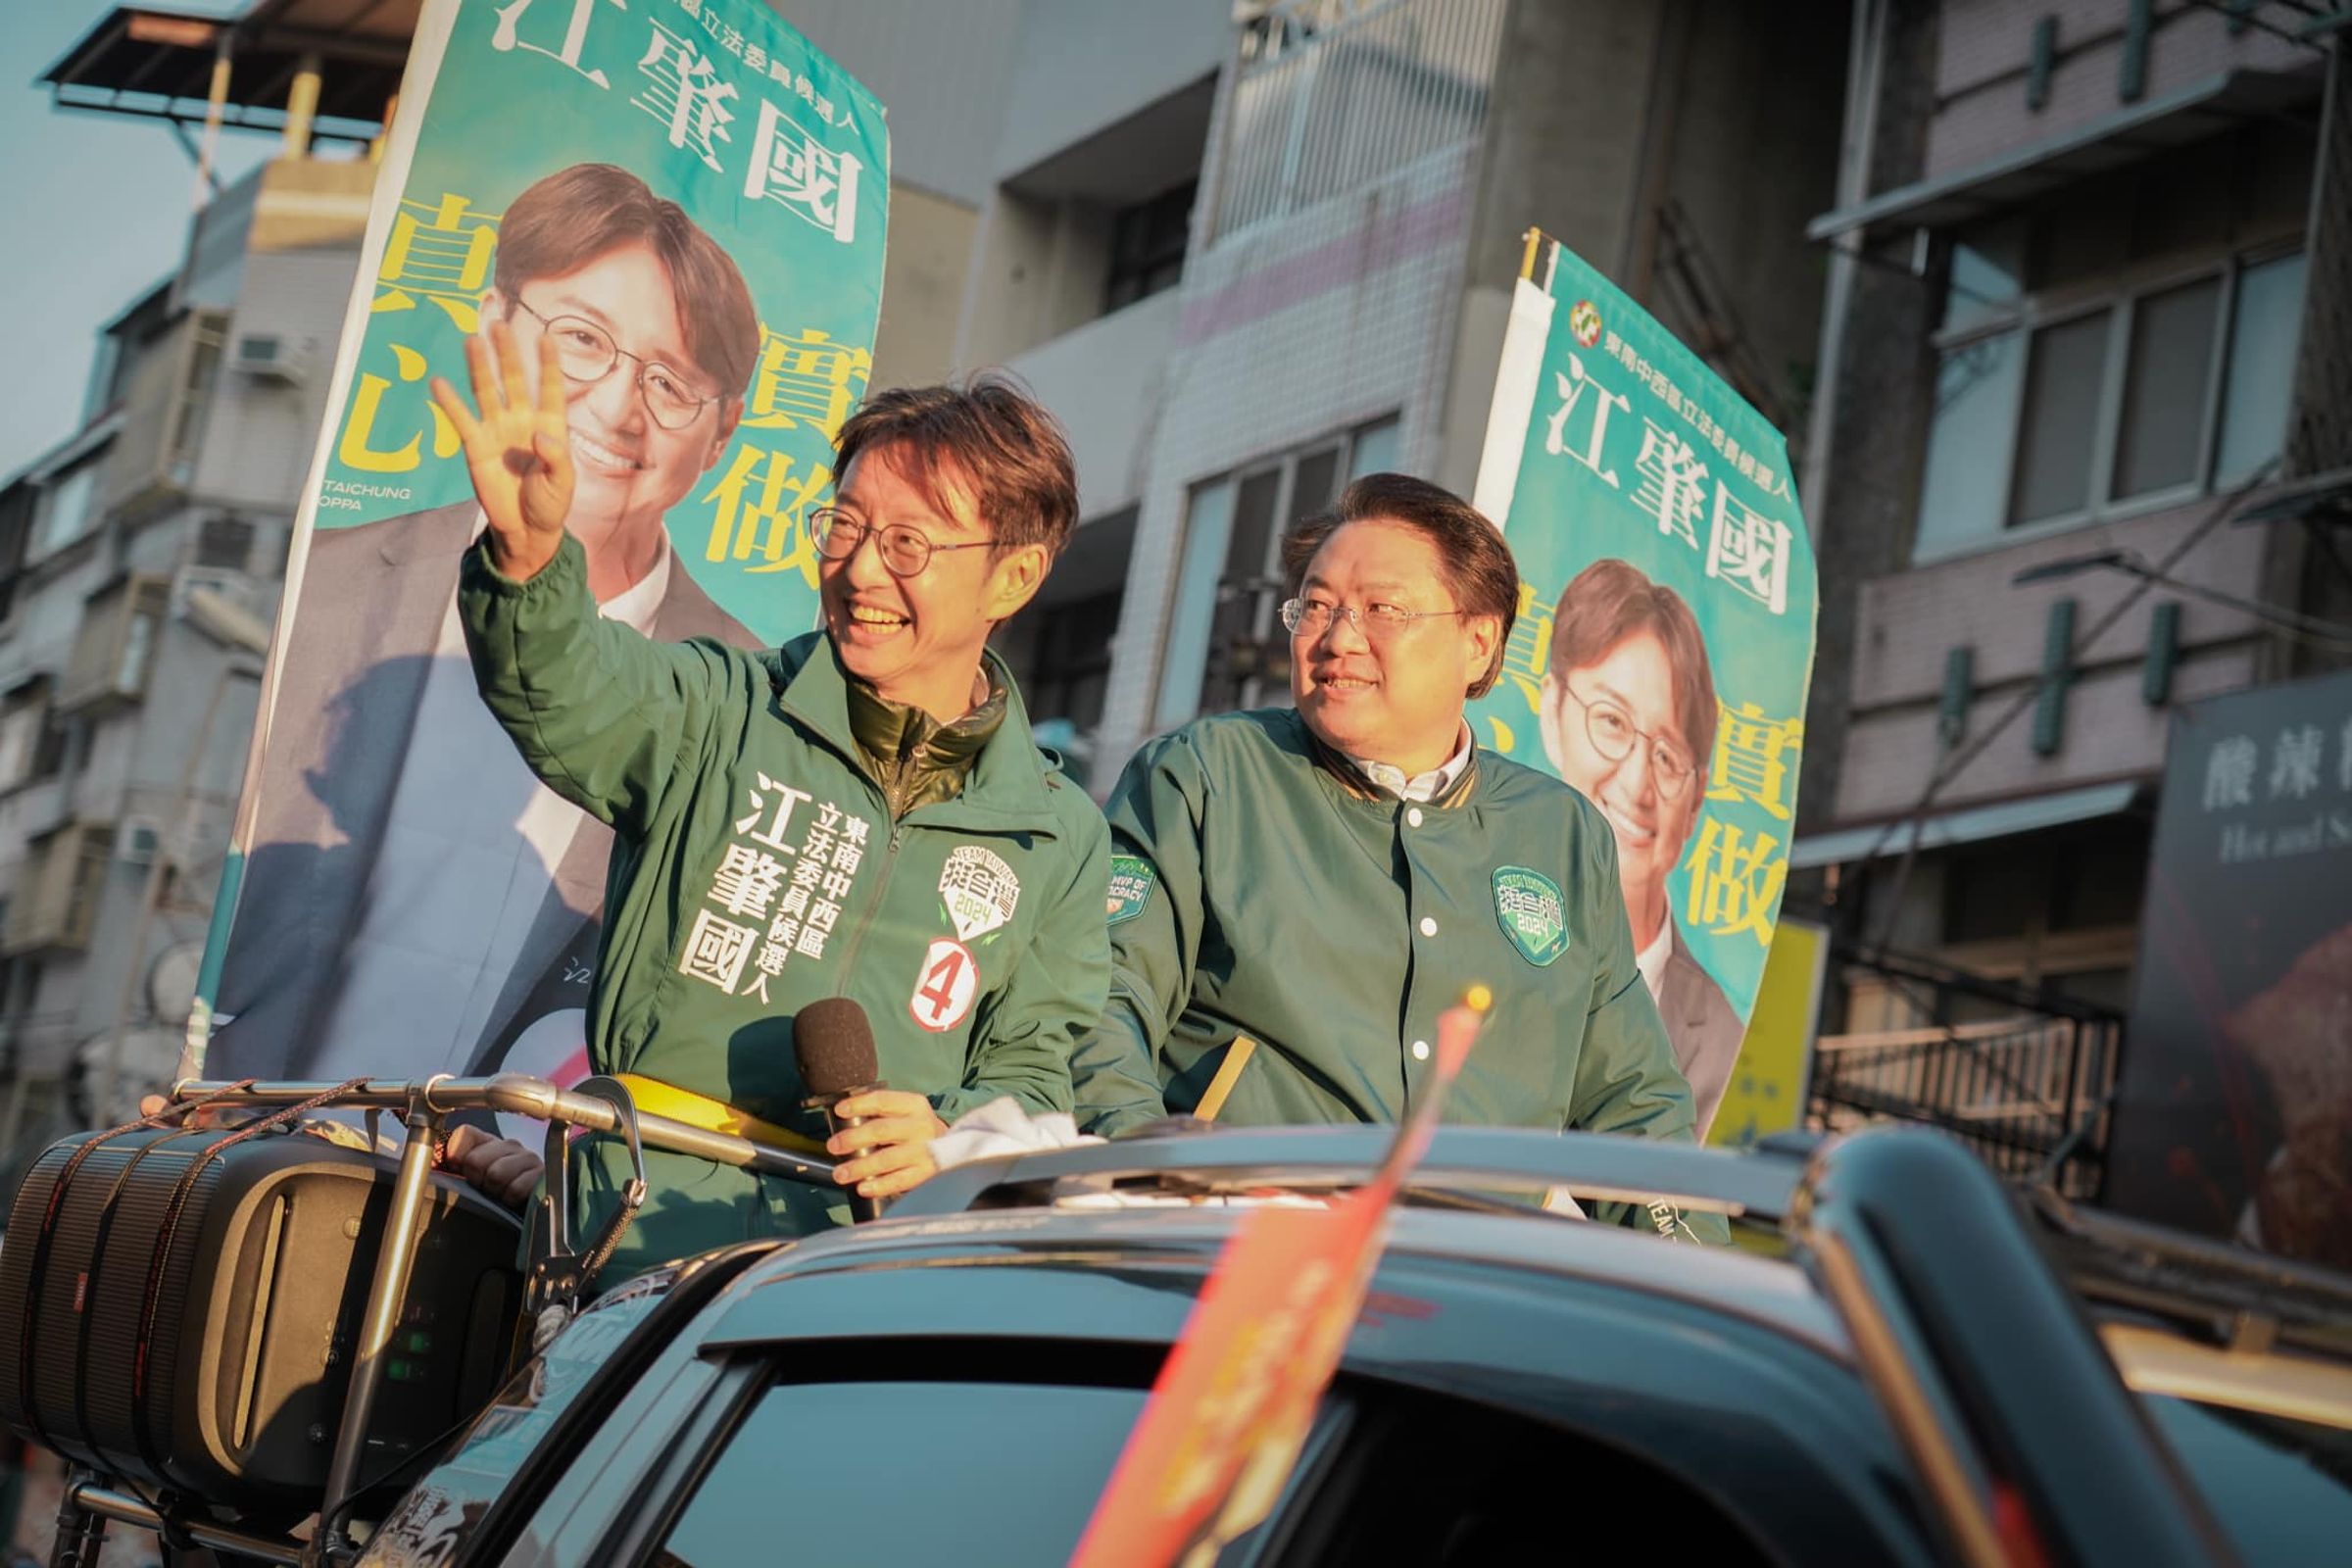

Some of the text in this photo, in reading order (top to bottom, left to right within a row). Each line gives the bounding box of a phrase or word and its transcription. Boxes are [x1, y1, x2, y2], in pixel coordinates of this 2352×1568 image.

[318, 495, 362, 511] OPPA
[323, 480, 412, 500] TAICHUNG
[1545, 351, 1792, 615] 江肇國
[1685, 695, 1804, 948] 實做
[678, 770, 813, 995] 江肇國
[740, 801, 843, 1005] 立法委員候選人
[794, 814, 869, 960] 東南中西區
[955, 893, 992, 925] 2024
[1133, 878, 1148, 891] OF
[1517, 912, 1549, 939] 2024
[919, 951, 965, 1021] 4
